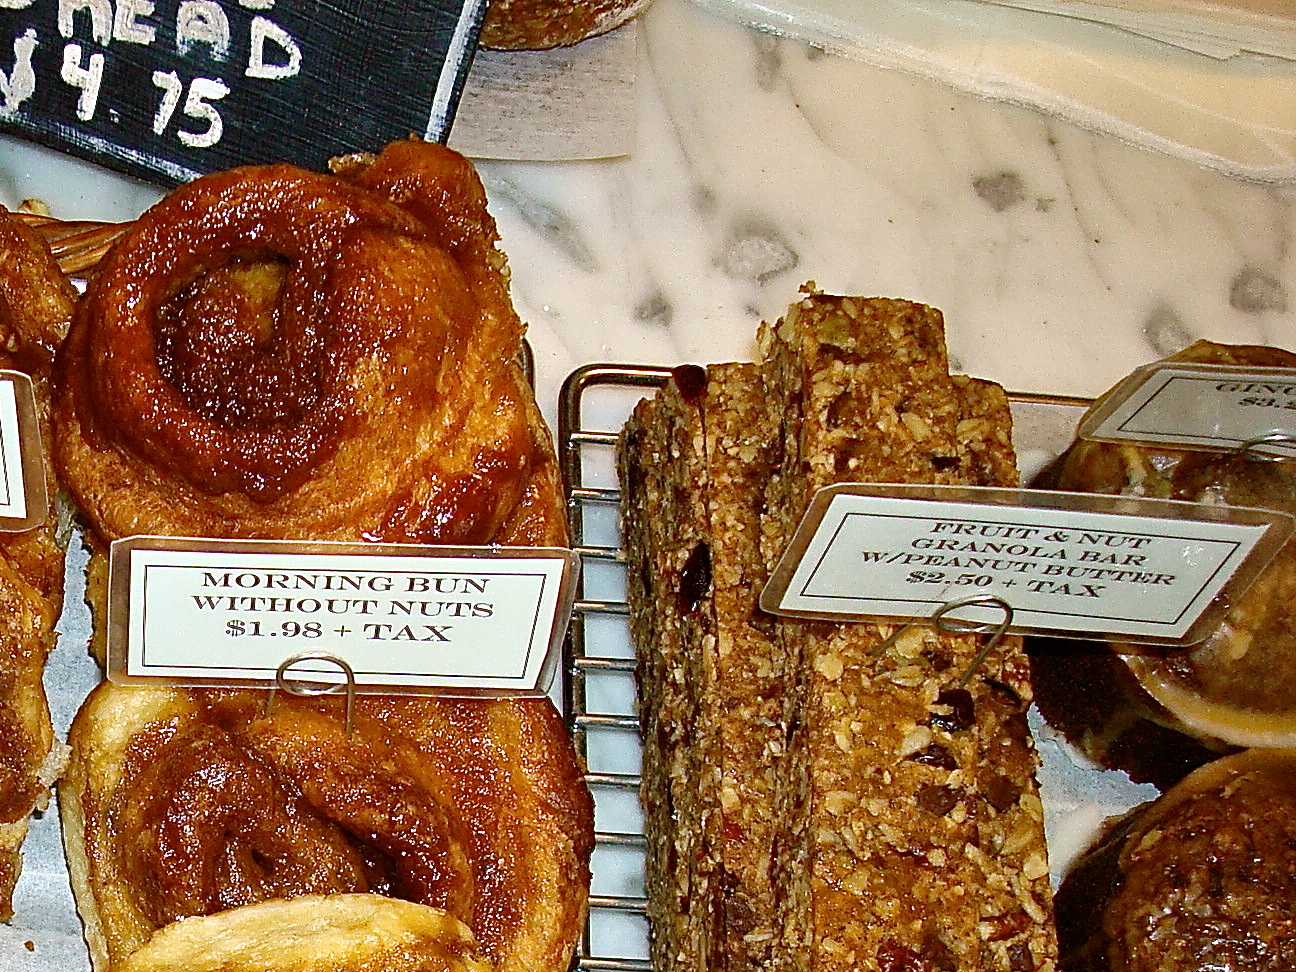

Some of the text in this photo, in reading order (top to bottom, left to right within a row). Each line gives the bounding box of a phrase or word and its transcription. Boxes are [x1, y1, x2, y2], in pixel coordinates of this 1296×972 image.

[930, 522, 1151, 550] FRUIT & NUT
[911, 538, 1148, 567] GRANOLA BAR
[201, 572, 491, 594] MORNING BUN
[861, 551, 1178, 588] W/PEANUT BUTTER
[906, 571, 1107, 599] $2.50 + TAX
[191, 595, 494, 618] WITHOUT NUTS
[225, 618, 454, 642] $1.98 + TAX
